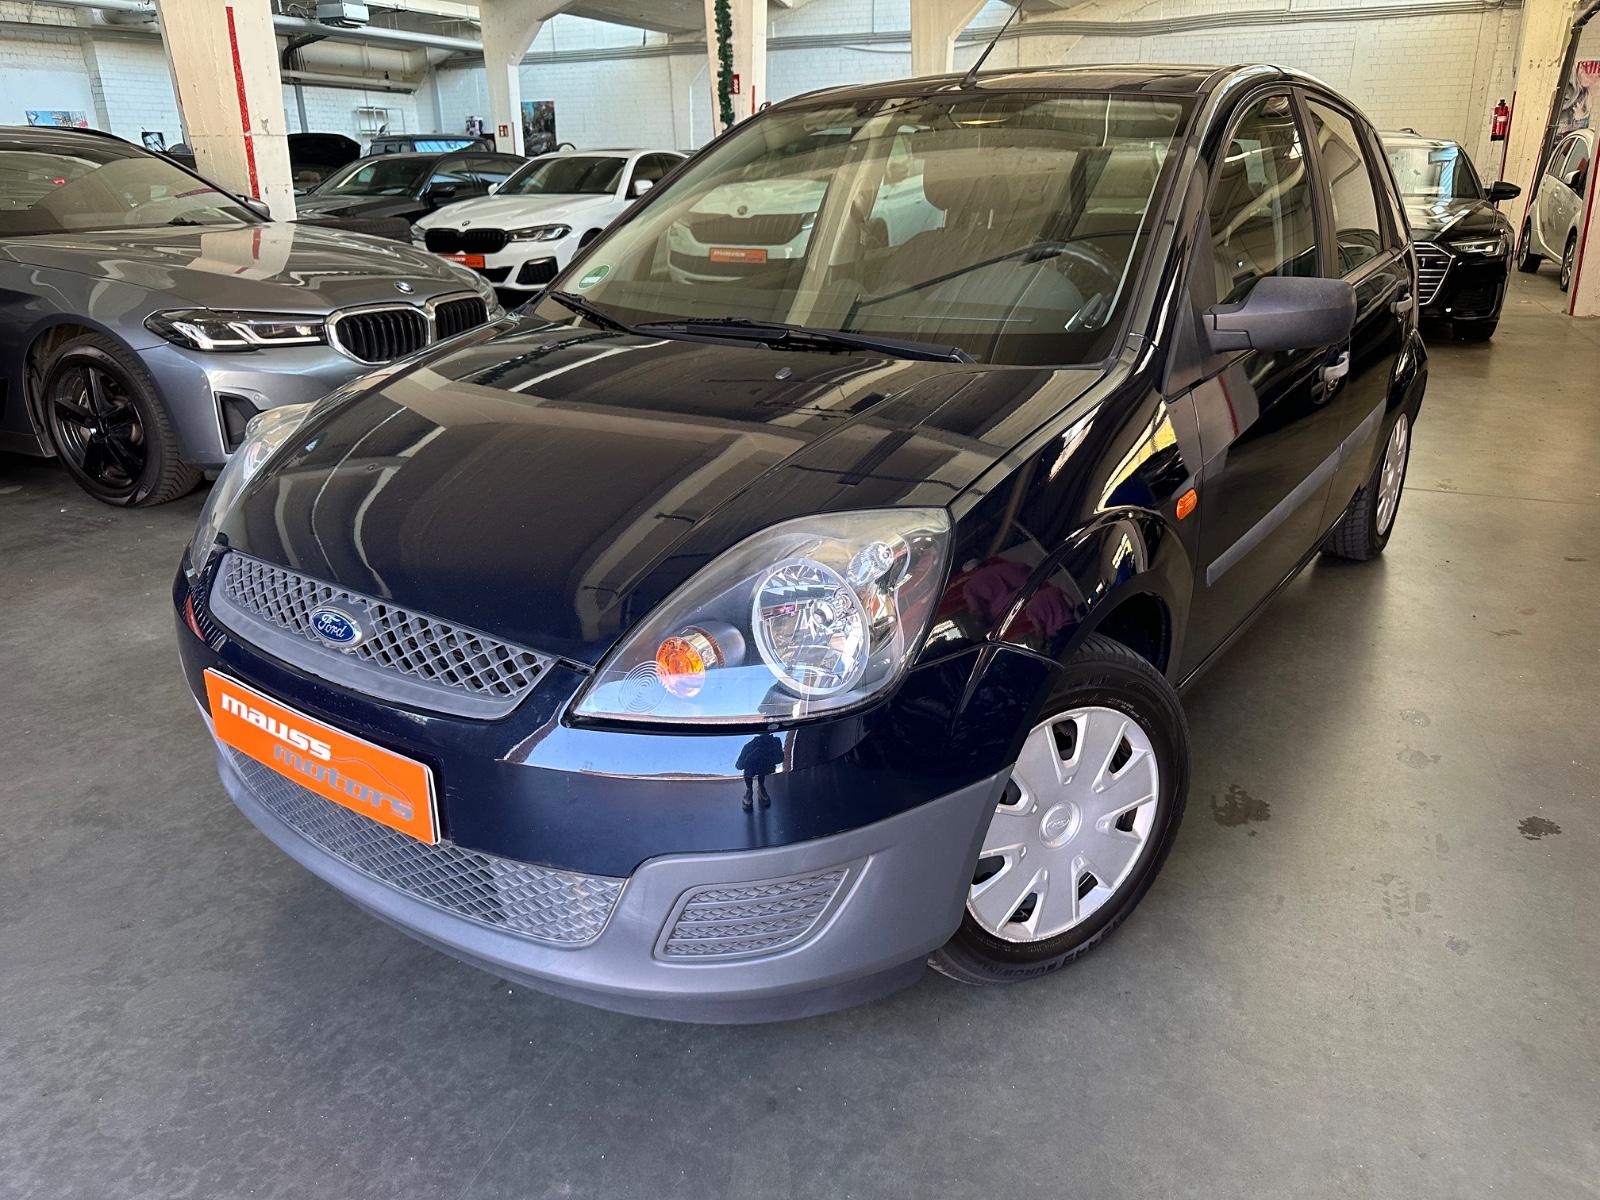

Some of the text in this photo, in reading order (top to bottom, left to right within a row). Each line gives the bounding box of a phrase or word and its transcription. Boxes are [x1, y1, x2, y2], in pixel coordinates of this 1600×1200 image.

[317, 613, 348, 638] Ford
[221, 691, 331, 761] mauss
[273, 743, 415, 822] motors
